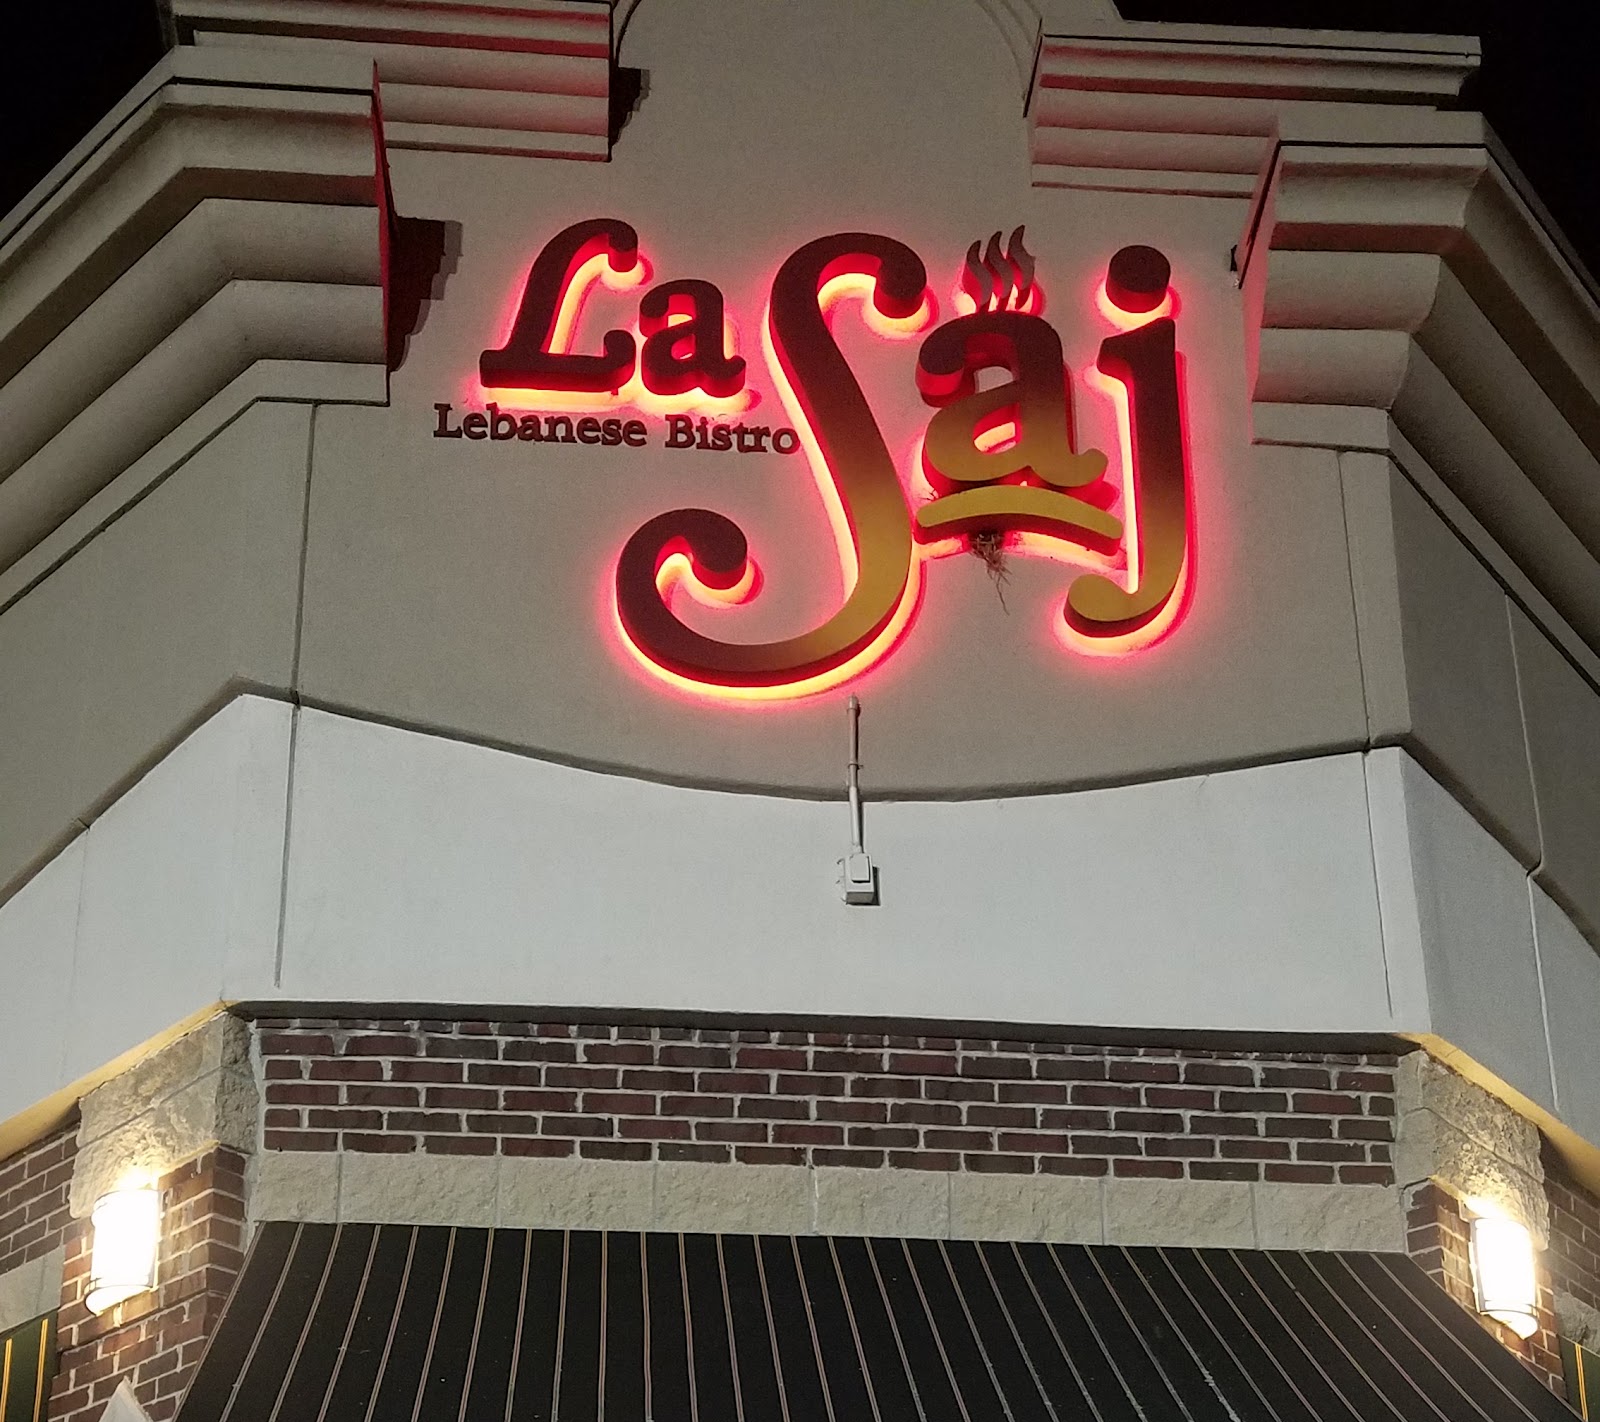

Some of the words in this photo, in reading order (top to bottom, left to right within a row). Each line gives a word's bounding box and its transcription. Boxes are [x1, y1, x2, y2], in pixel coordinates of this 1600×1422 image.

[433, 401, 648, 447] Lebanese
[664, 413, 801, 455] Bistro
[478, 218, 747, 397] La
[615, 225, 1187, 690] Saj
